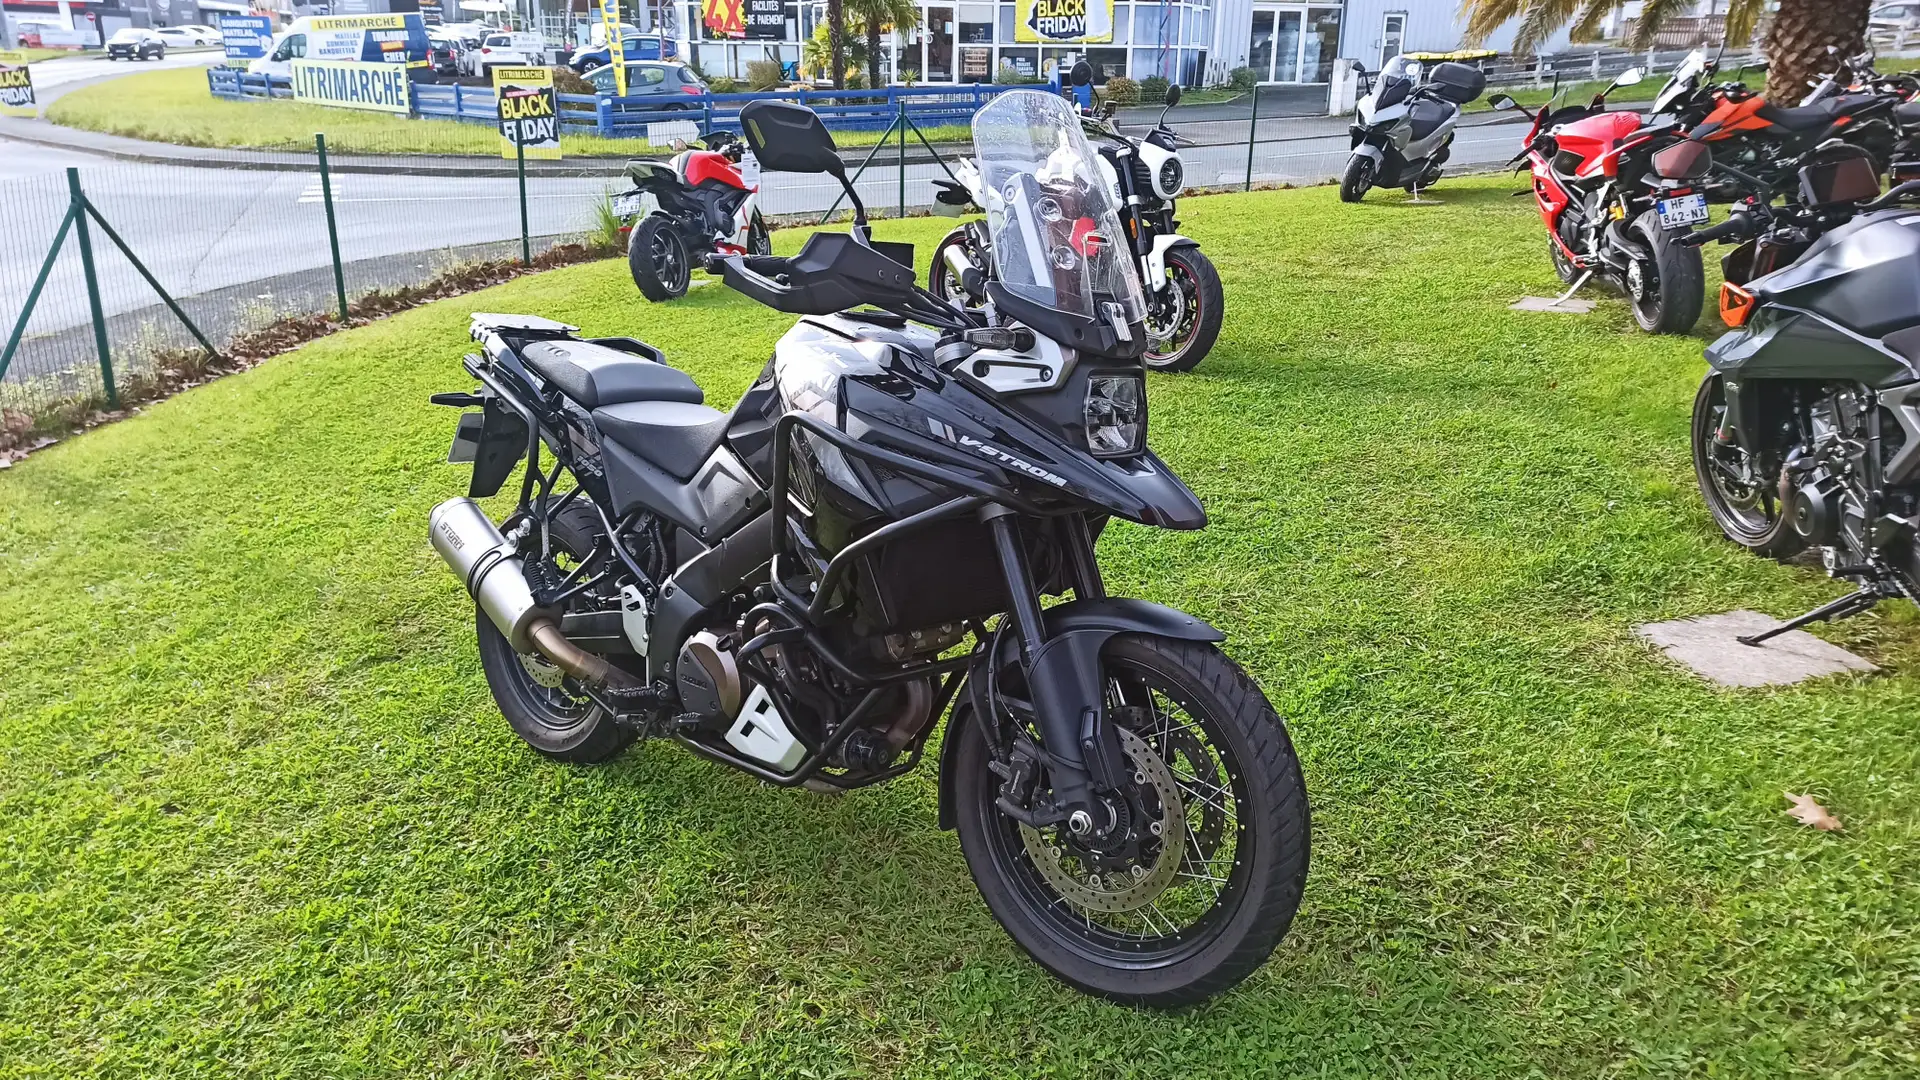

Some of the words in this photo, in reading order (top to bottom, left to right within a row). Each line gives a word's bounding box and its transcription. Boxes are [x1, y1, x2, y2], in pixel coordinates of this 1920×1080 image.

[1037, 0, 1085, 17] BLACK
[748, 14, 756, 25] DE
[757, 14, 784, 25] PAIEMENT
[1037, 15, 1087, 33] FRIDAY
[295, 66, 405, 107] LITRIMARCHÉ
[501, 94, 552, 119] BLACK
[1663, 207, 1706, 224] 842-NX
[577, 455, 603, 477] 1050
